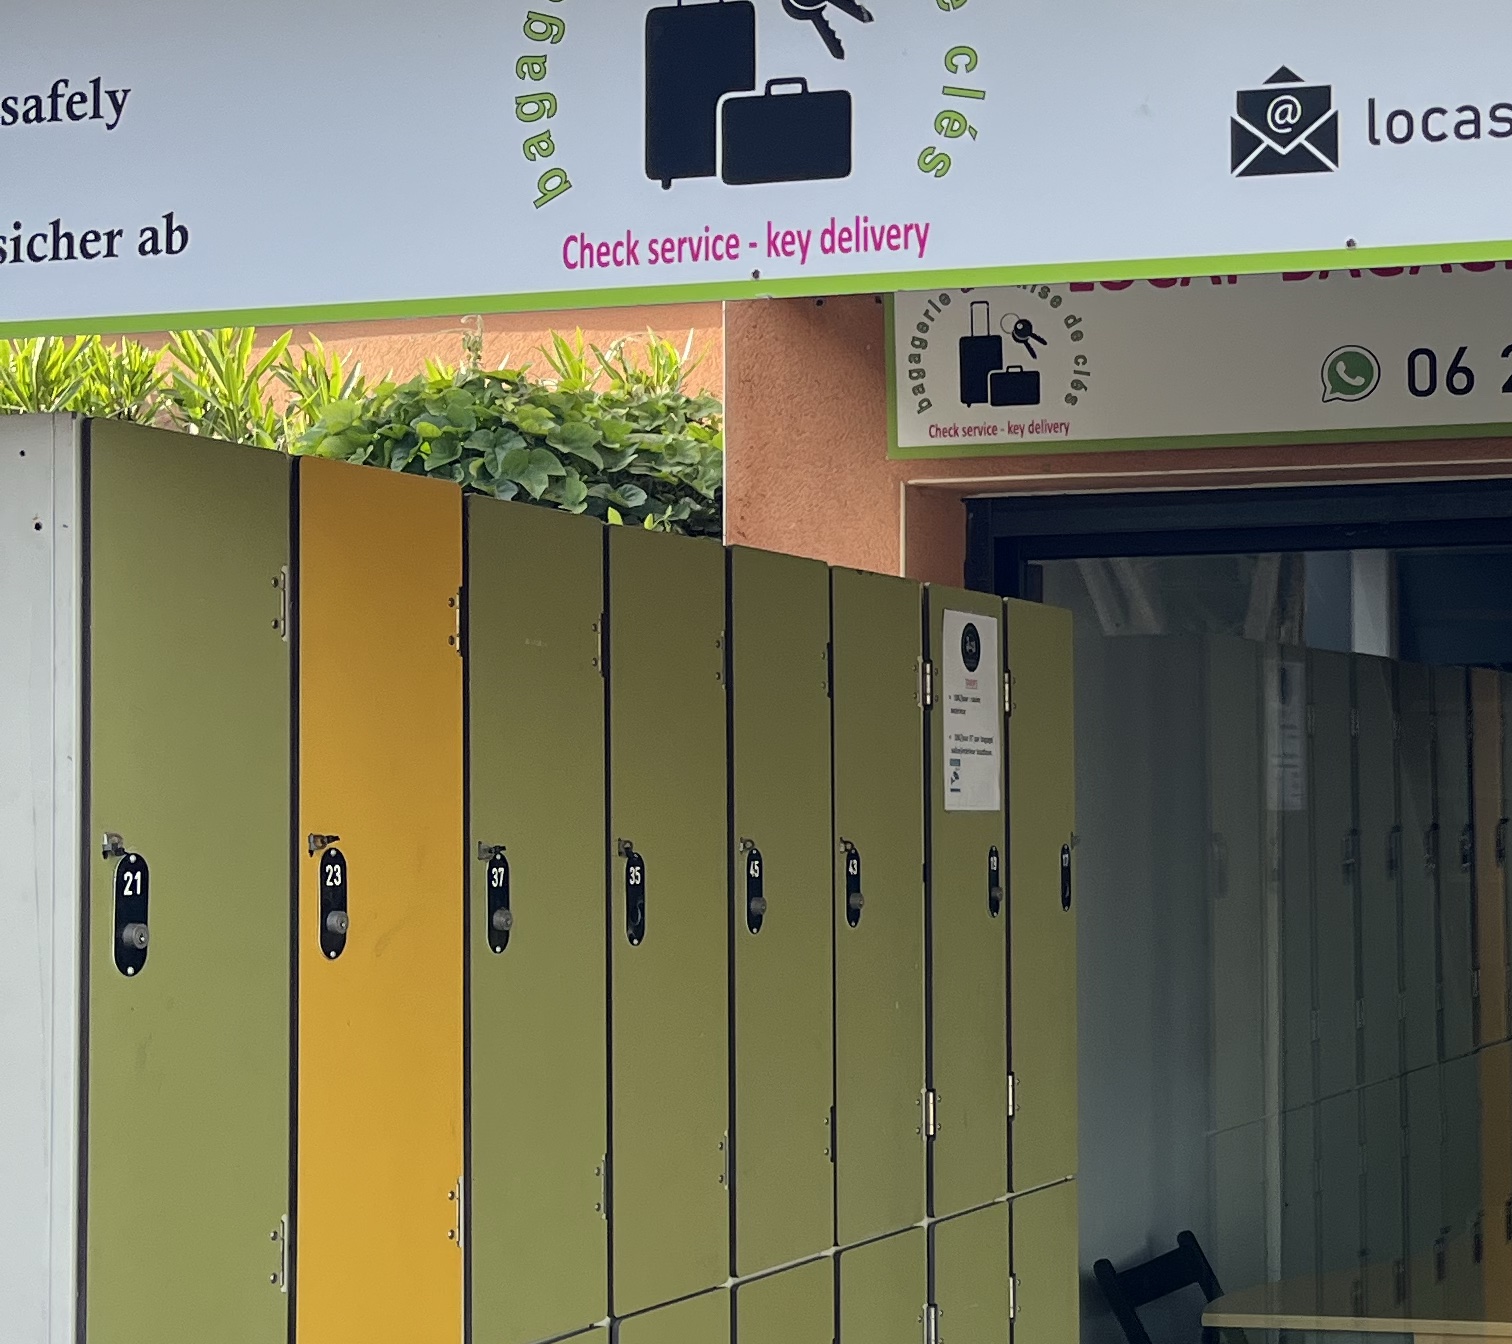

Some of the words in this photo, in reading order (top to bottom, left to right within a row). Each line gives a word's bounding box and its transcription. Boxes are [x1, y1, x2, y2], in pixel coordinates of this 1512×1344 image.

[0, 76, 131, 130] safely
[917, 45, 986, 178] clés
[138, 211, 189, 256] ab
[562, 229, 639, 270] Check
[648, 225, 740, 267] service
[767, 221, 811, 265] key
[820, 216, 930, 258] delivery
[1064, 314, 1082, 342] de
[1406, 347, 1475, 398] 06
[928, 423, 959, 438] Check
[962, 421, 998, 437] service
[1008, 421, 1025, 438] key
[1028, 419, 1070, 436] delivery
[325, 864, 342, 886] 23
[491, 867, 505, 888] 37
[629, 866, 641, 885] 35
[750, 861, 760, 878] 45
[848, 859, 858, 876] 43
[123, 871, 142, 896] 21
